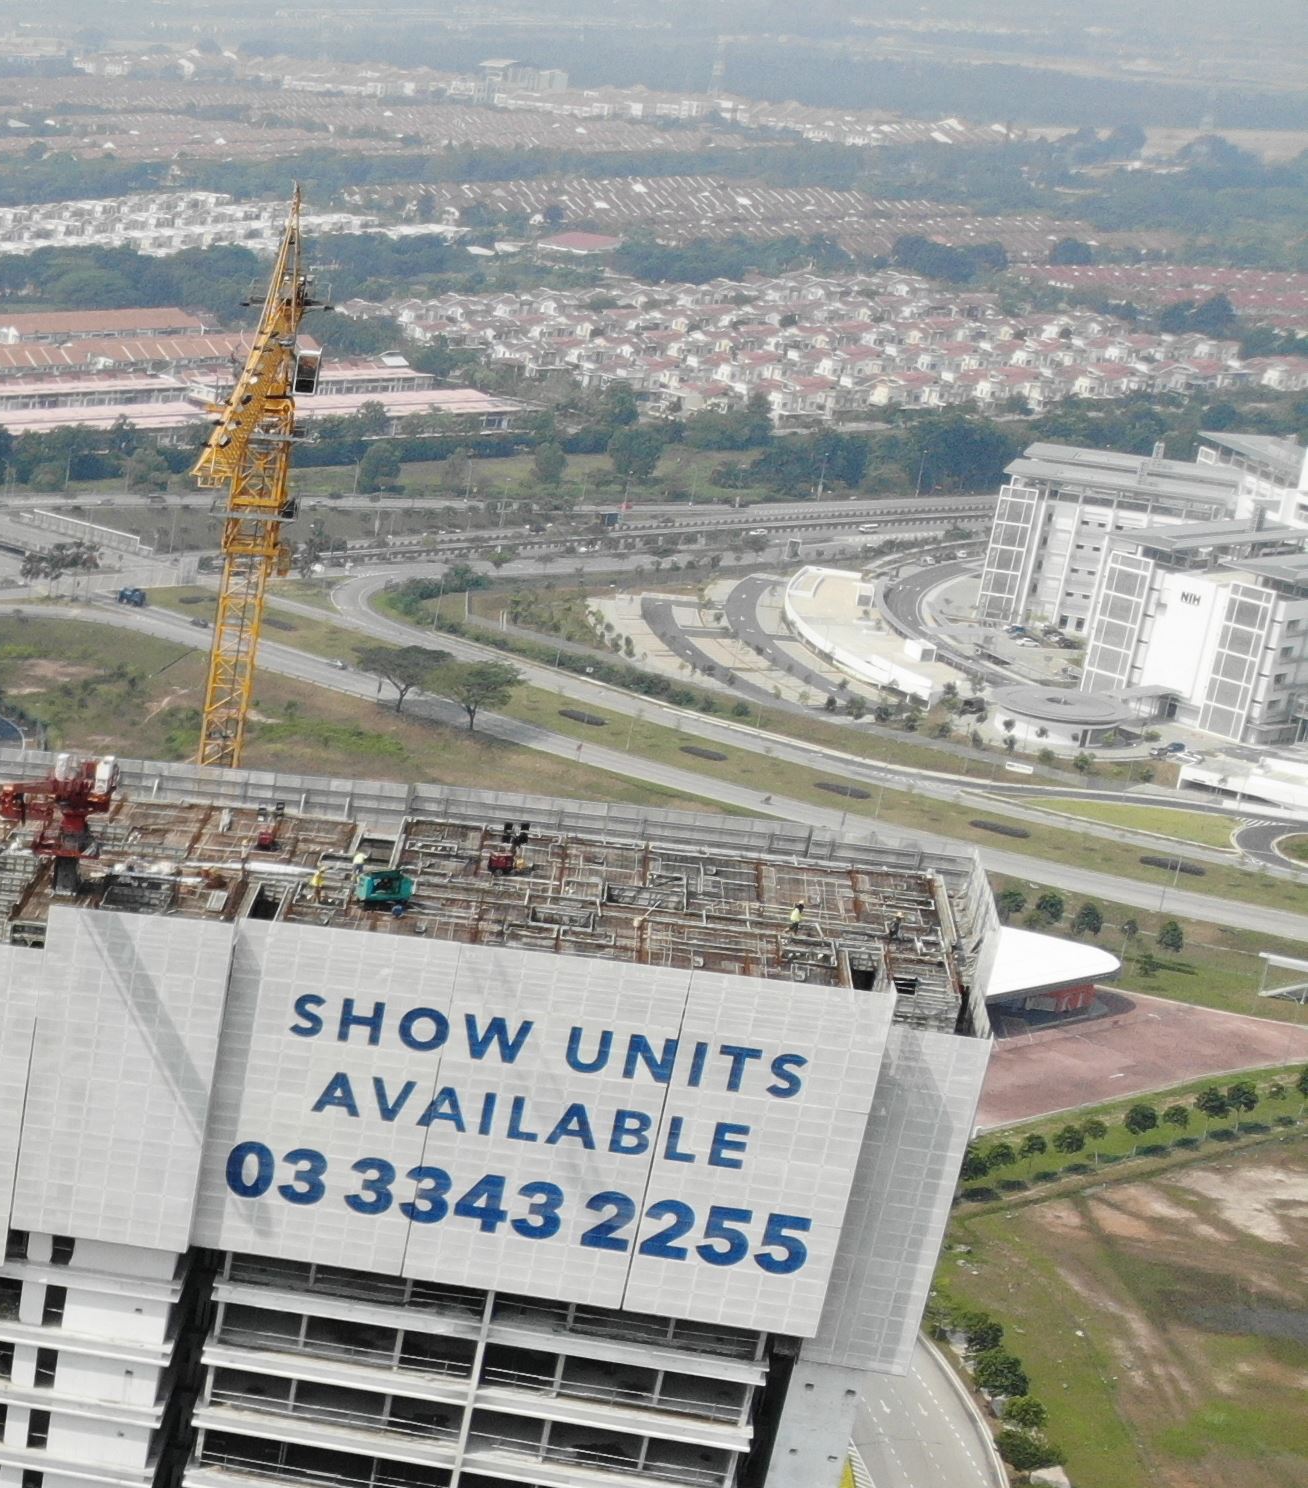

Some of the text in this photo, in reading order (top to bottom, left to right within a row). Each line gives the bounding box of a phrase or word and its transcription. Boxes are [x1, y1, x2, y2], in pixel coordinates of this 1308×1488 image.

[289, 994, 808, 1099] SHOW UNITS
[311, 1072, 751, 1170] AVAILABLE
[226, 1141, 812, 1275] 03 3343 2255
